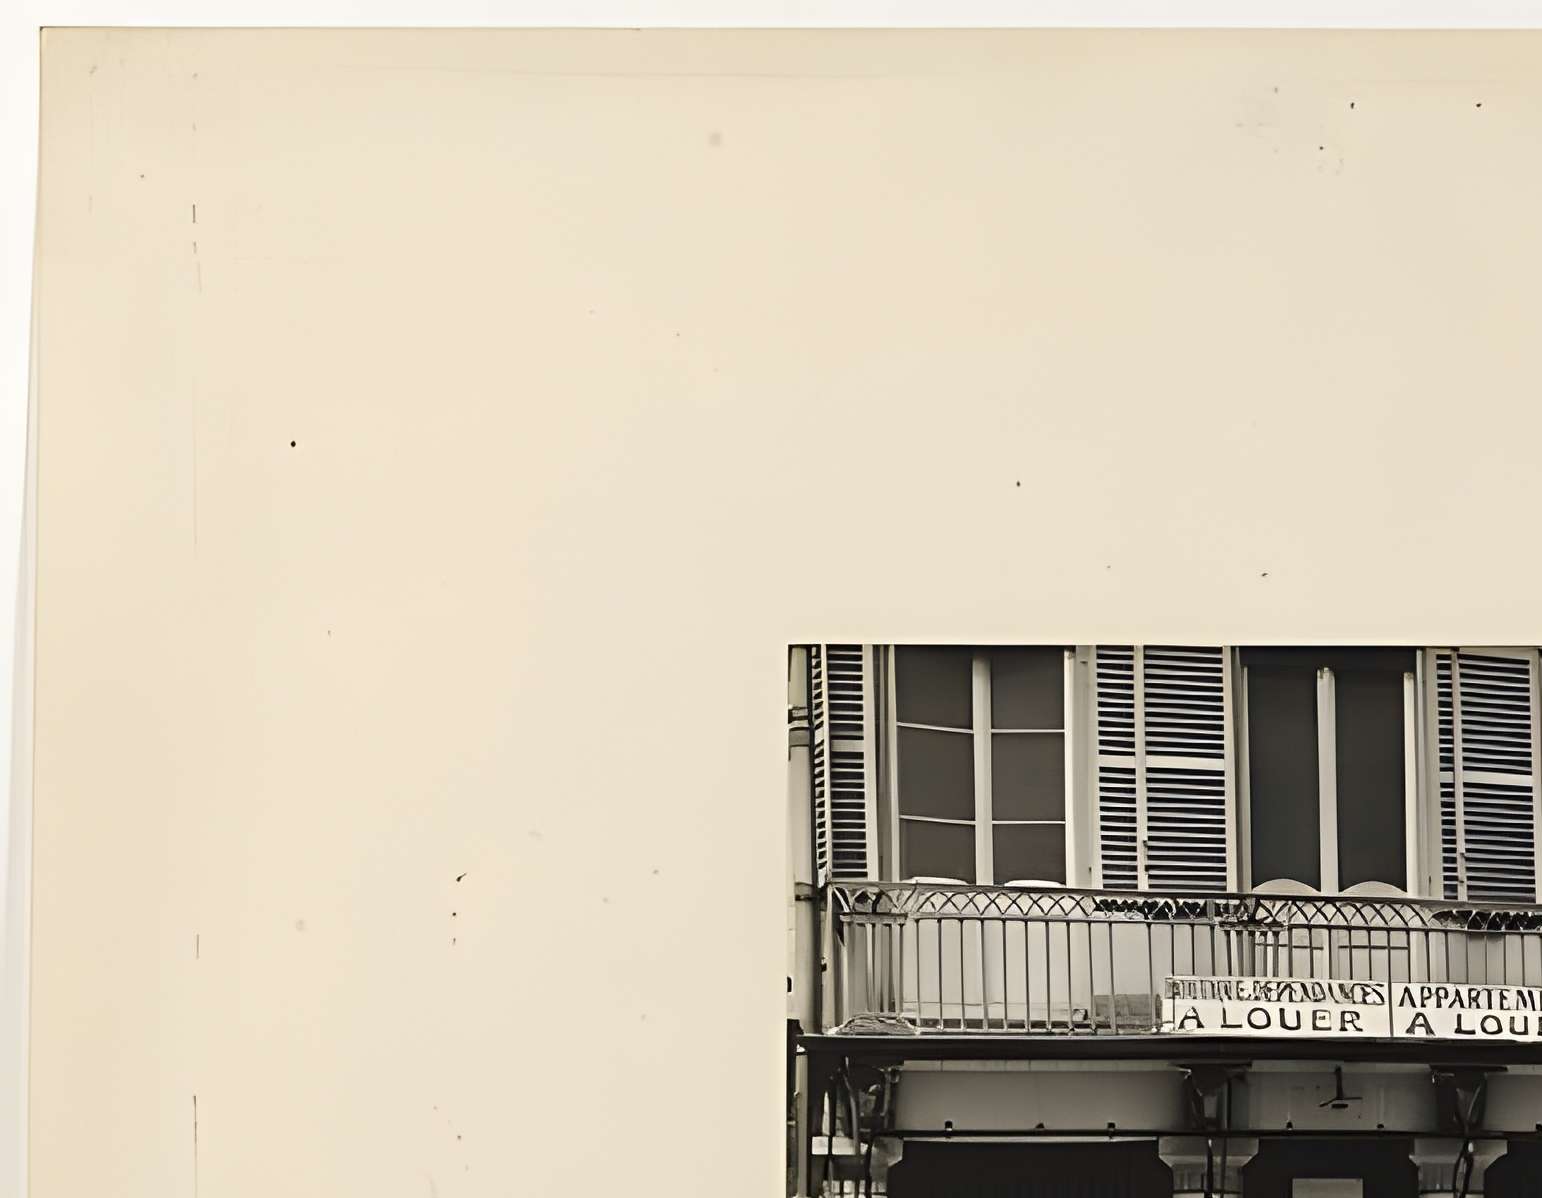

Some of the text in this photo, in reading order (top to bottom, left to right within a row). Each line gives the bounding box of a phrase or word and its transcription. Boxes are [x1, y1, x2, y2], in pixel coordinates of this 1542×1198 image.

[1178, 1005, 1364, 1032] A LOUER
[1405, 1012, 1436, 1037] A
